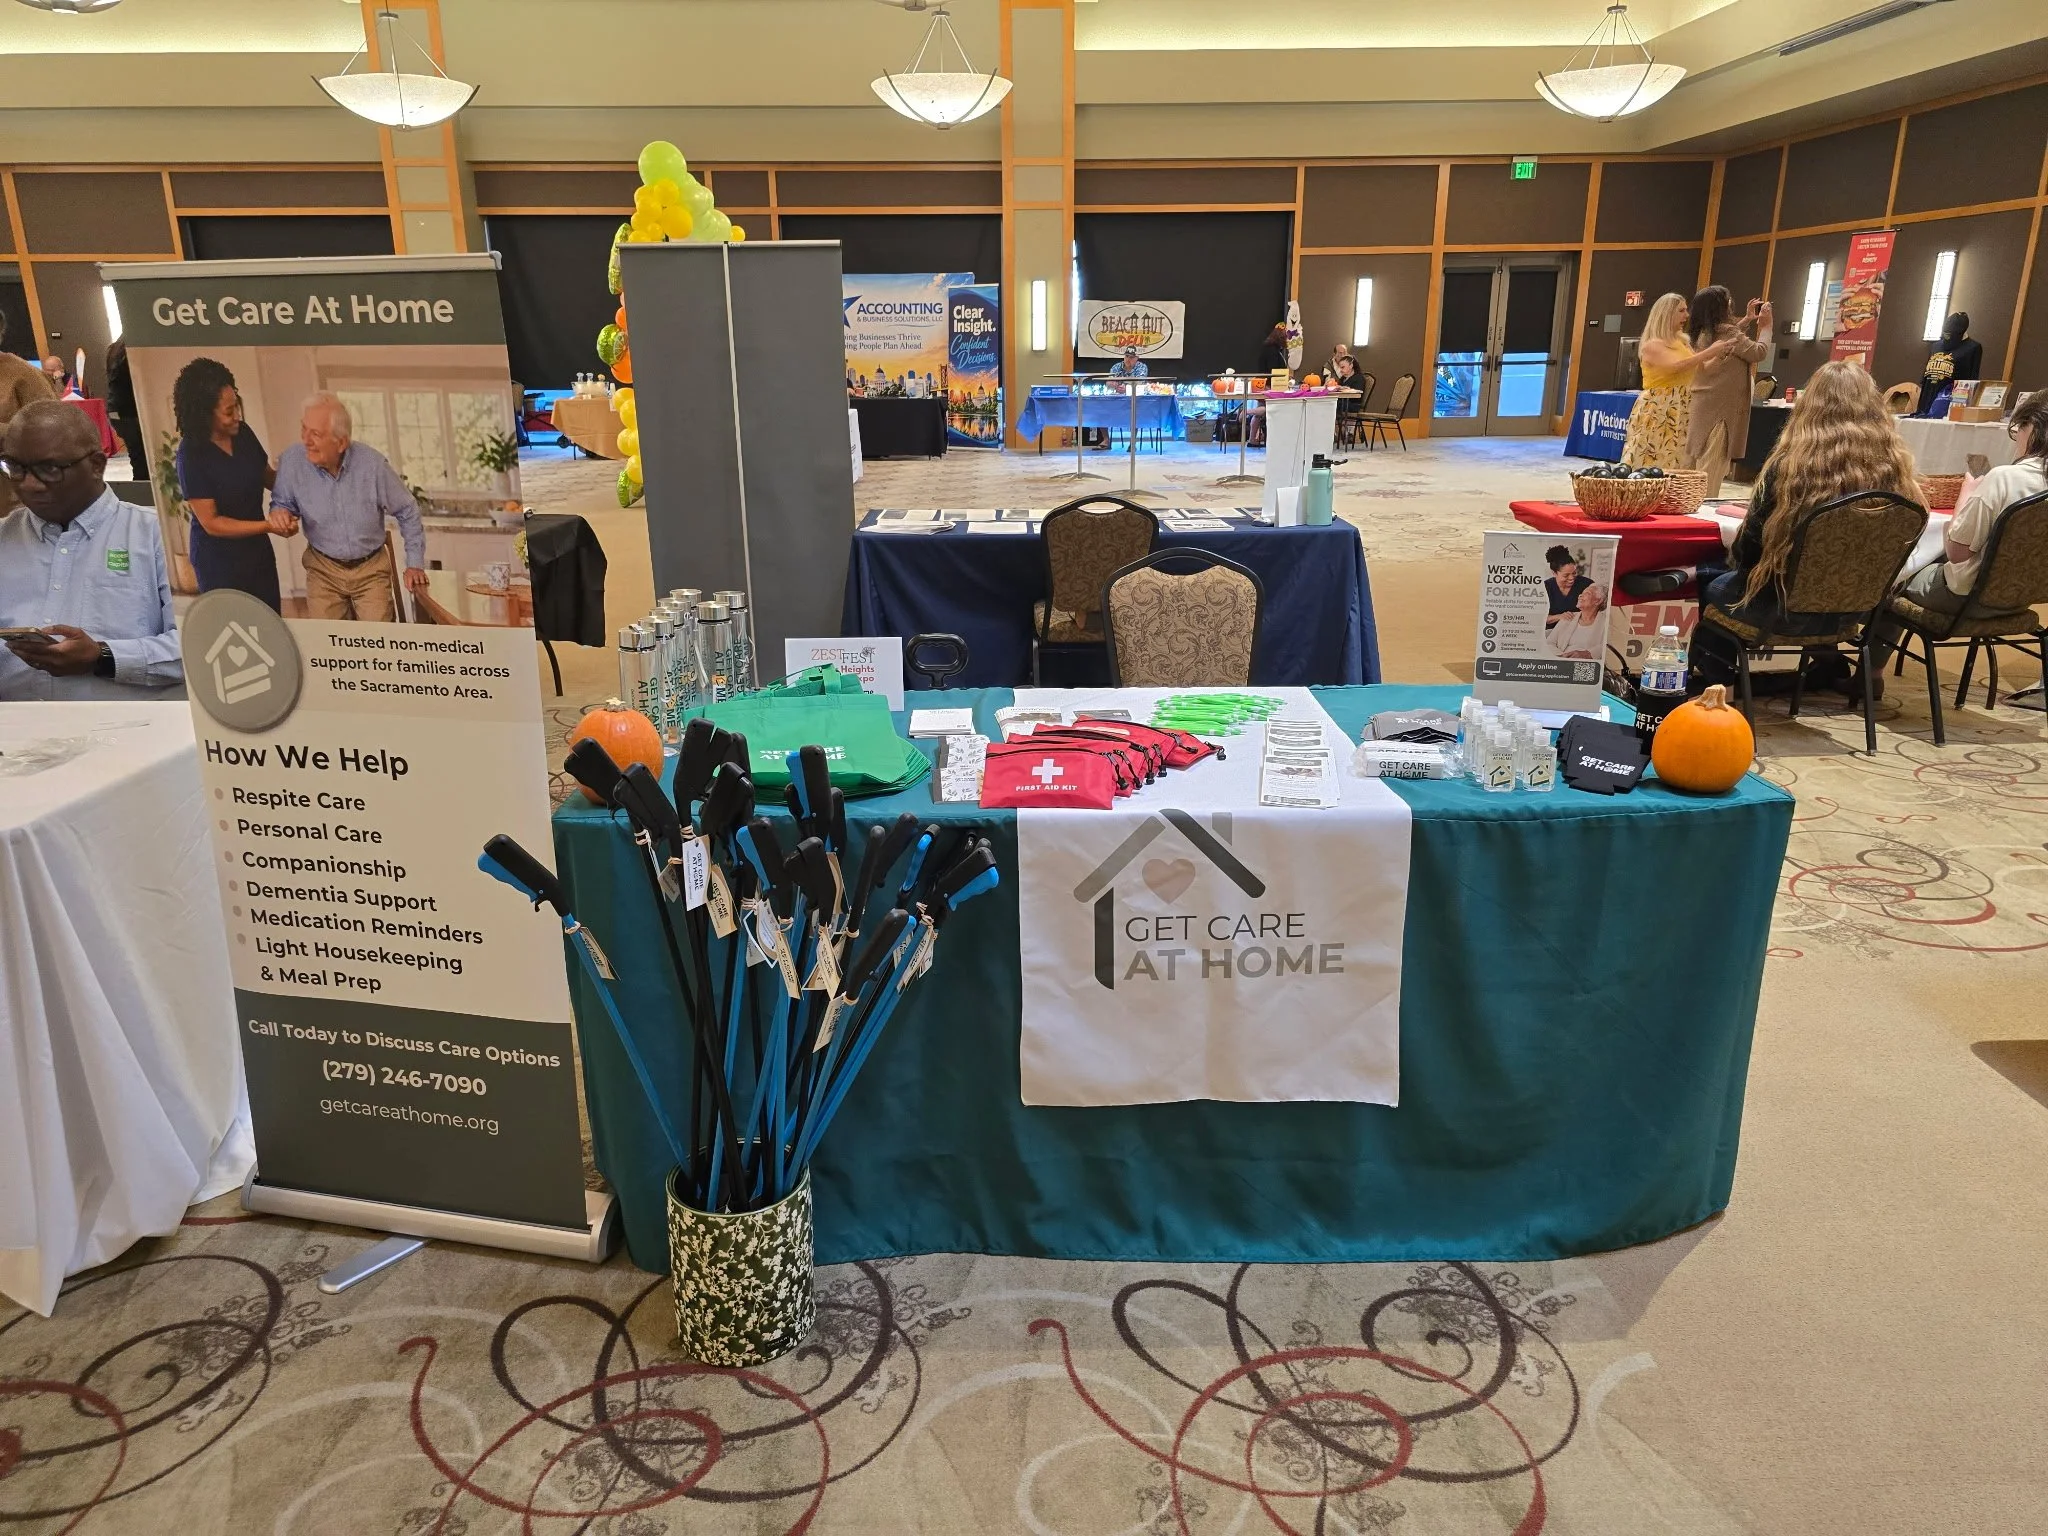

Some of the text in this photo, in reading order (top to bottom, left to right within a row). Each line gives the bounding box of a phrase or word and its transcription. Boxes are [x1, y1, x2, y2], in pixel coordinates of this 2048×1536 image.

[1516, 163, 1534, 178] EXIT
[152, 295, 454, 327] Get Care At Home
[857, 303, 943, 315] ACCOUNTING
[954, 305, 984, 319] Clear
[954, 319, 996, 335] Insight.
[1102, 312, 1165, 334] BEACH HUT
[859, 342, 882, 351] People
[950, 335, 991, 355] Confident
[1117, 335, 1144, 347] DELI
[957, 352, 996, 369] Decisions.
[1488, 565, 1523, 575] WE'RE
[1487, 575, 1542, 585] LOOKING
[1486, 587, 1545, 597] FOR HCAs
[328, 634, 484, 655] Trusted non-medical
[715, 651, 724, 666] AT
[811, 649, 844, 660] ZEST
[842, 652, 874, 663] FEST
[310, 656, 510, 678] support for families across
[841, 665, 874, 674] Heights
[332, 677, 494, 699] the Sacramento Area.
[727, 675, 735, 699] CAR
[860, 675, 874, 683] xpo
[638, 680, 648, 697] AT
[650, 677, 661, 736] GET CAR
[1636, 722, 1645, 731] AT
[1637, 713, 1653, 722] GET
[205, 740, 409, 781] How We Help
[1379, 761, 1431, 770] GET CARE
[1581, 756, 1636, 772] GET CARE
[1395, 770, 1429, 778] HOME
[1597, 764, 1630, 776] HOME
[232, 788, 366, 811] Respite Care
[238, 819, 383, 844] Personal Care
[242, 851, 407, 882] Companionship
[246, 881, 437, 912] Dementia Support
[712, 883, 729, 917] GET CARE
[251, 909, 483, 944] Medication Reminders
[1126, 913, 1306, 941] GET CARE
[256, 937, 463, 974] Light Housekeeping
[1124, 943, 1345, 981] AT HOME
[261, 966, 382, 993] & Meal Prep
[248, 1020, 561, 1068] Call Today to Discuss Care Options
[322, 1059, 487, 1096] (279) 246-7090
[320, 1096, 499, 1135] getcareathome.org
